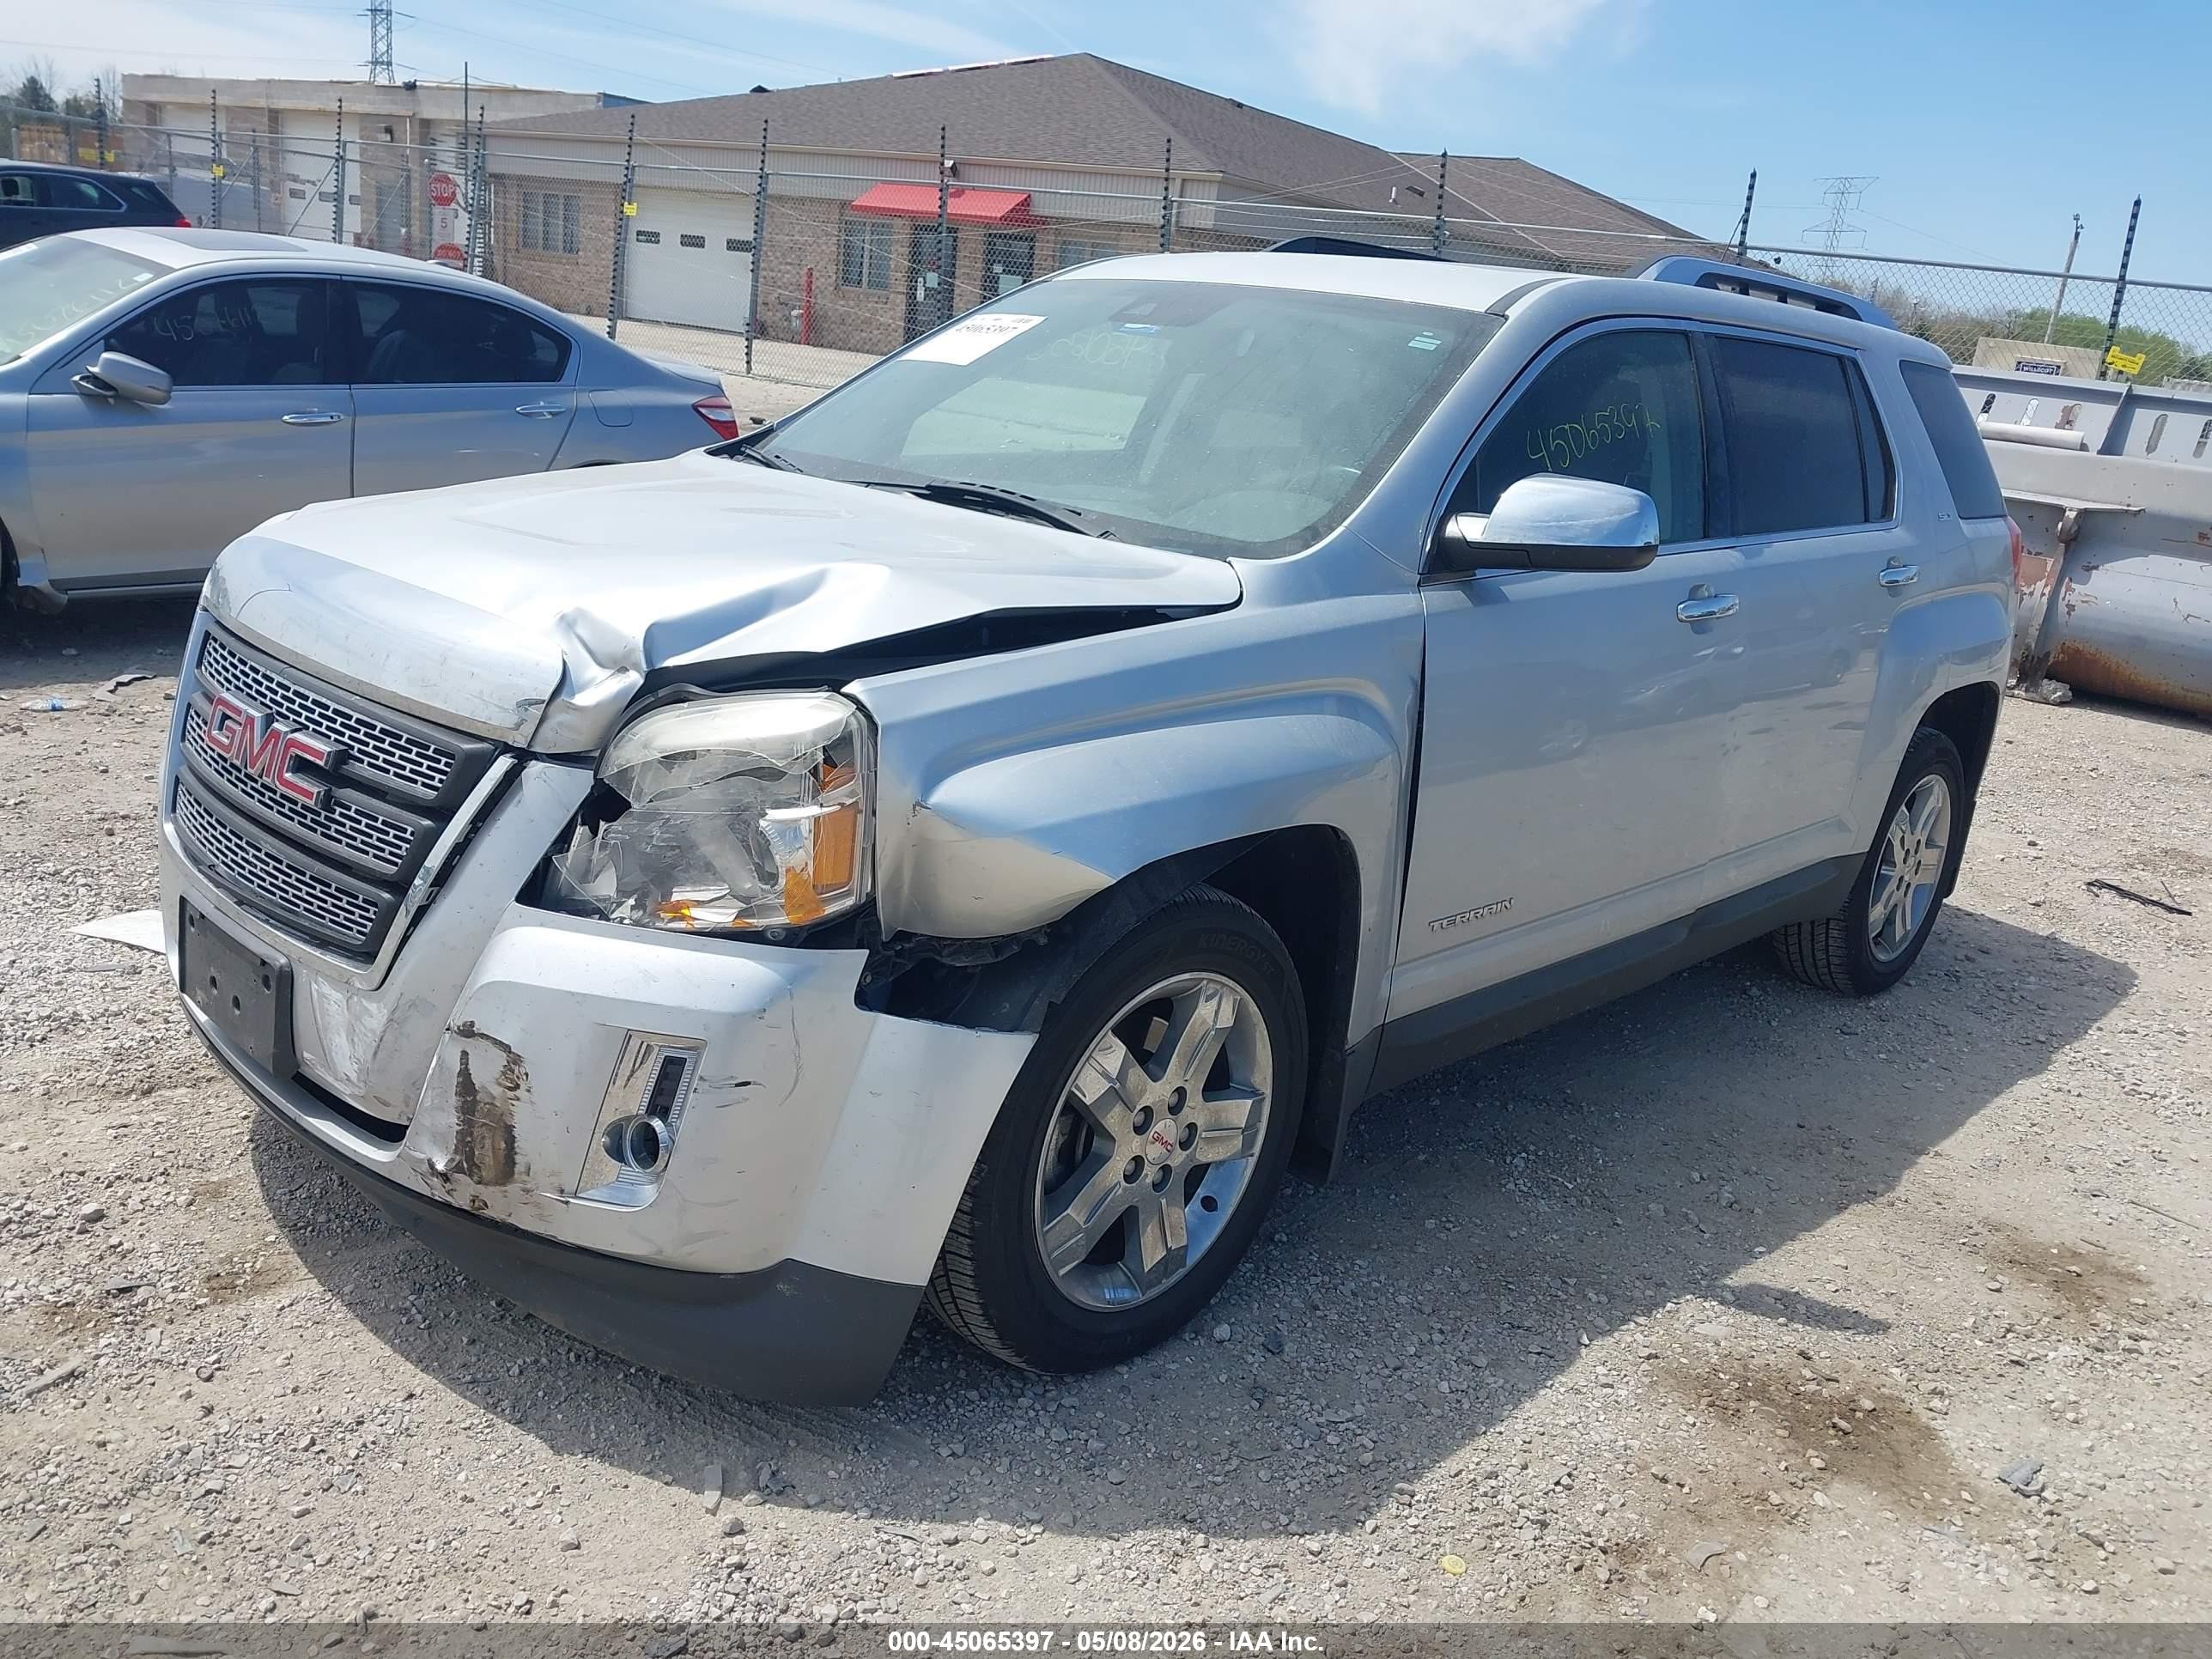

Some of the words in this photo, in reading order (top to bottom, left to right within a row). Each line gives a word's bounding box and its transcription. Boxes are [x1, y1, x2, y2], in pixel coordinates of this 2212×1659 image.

[431, 183, 455, 198] STOP
[441, 217, 448, 228] 5
[206, 692, 337, 811] GMC
[1428, 896, 1514, 933] TERRAIN
[1152, 1130, 1174, 1153] GMC
